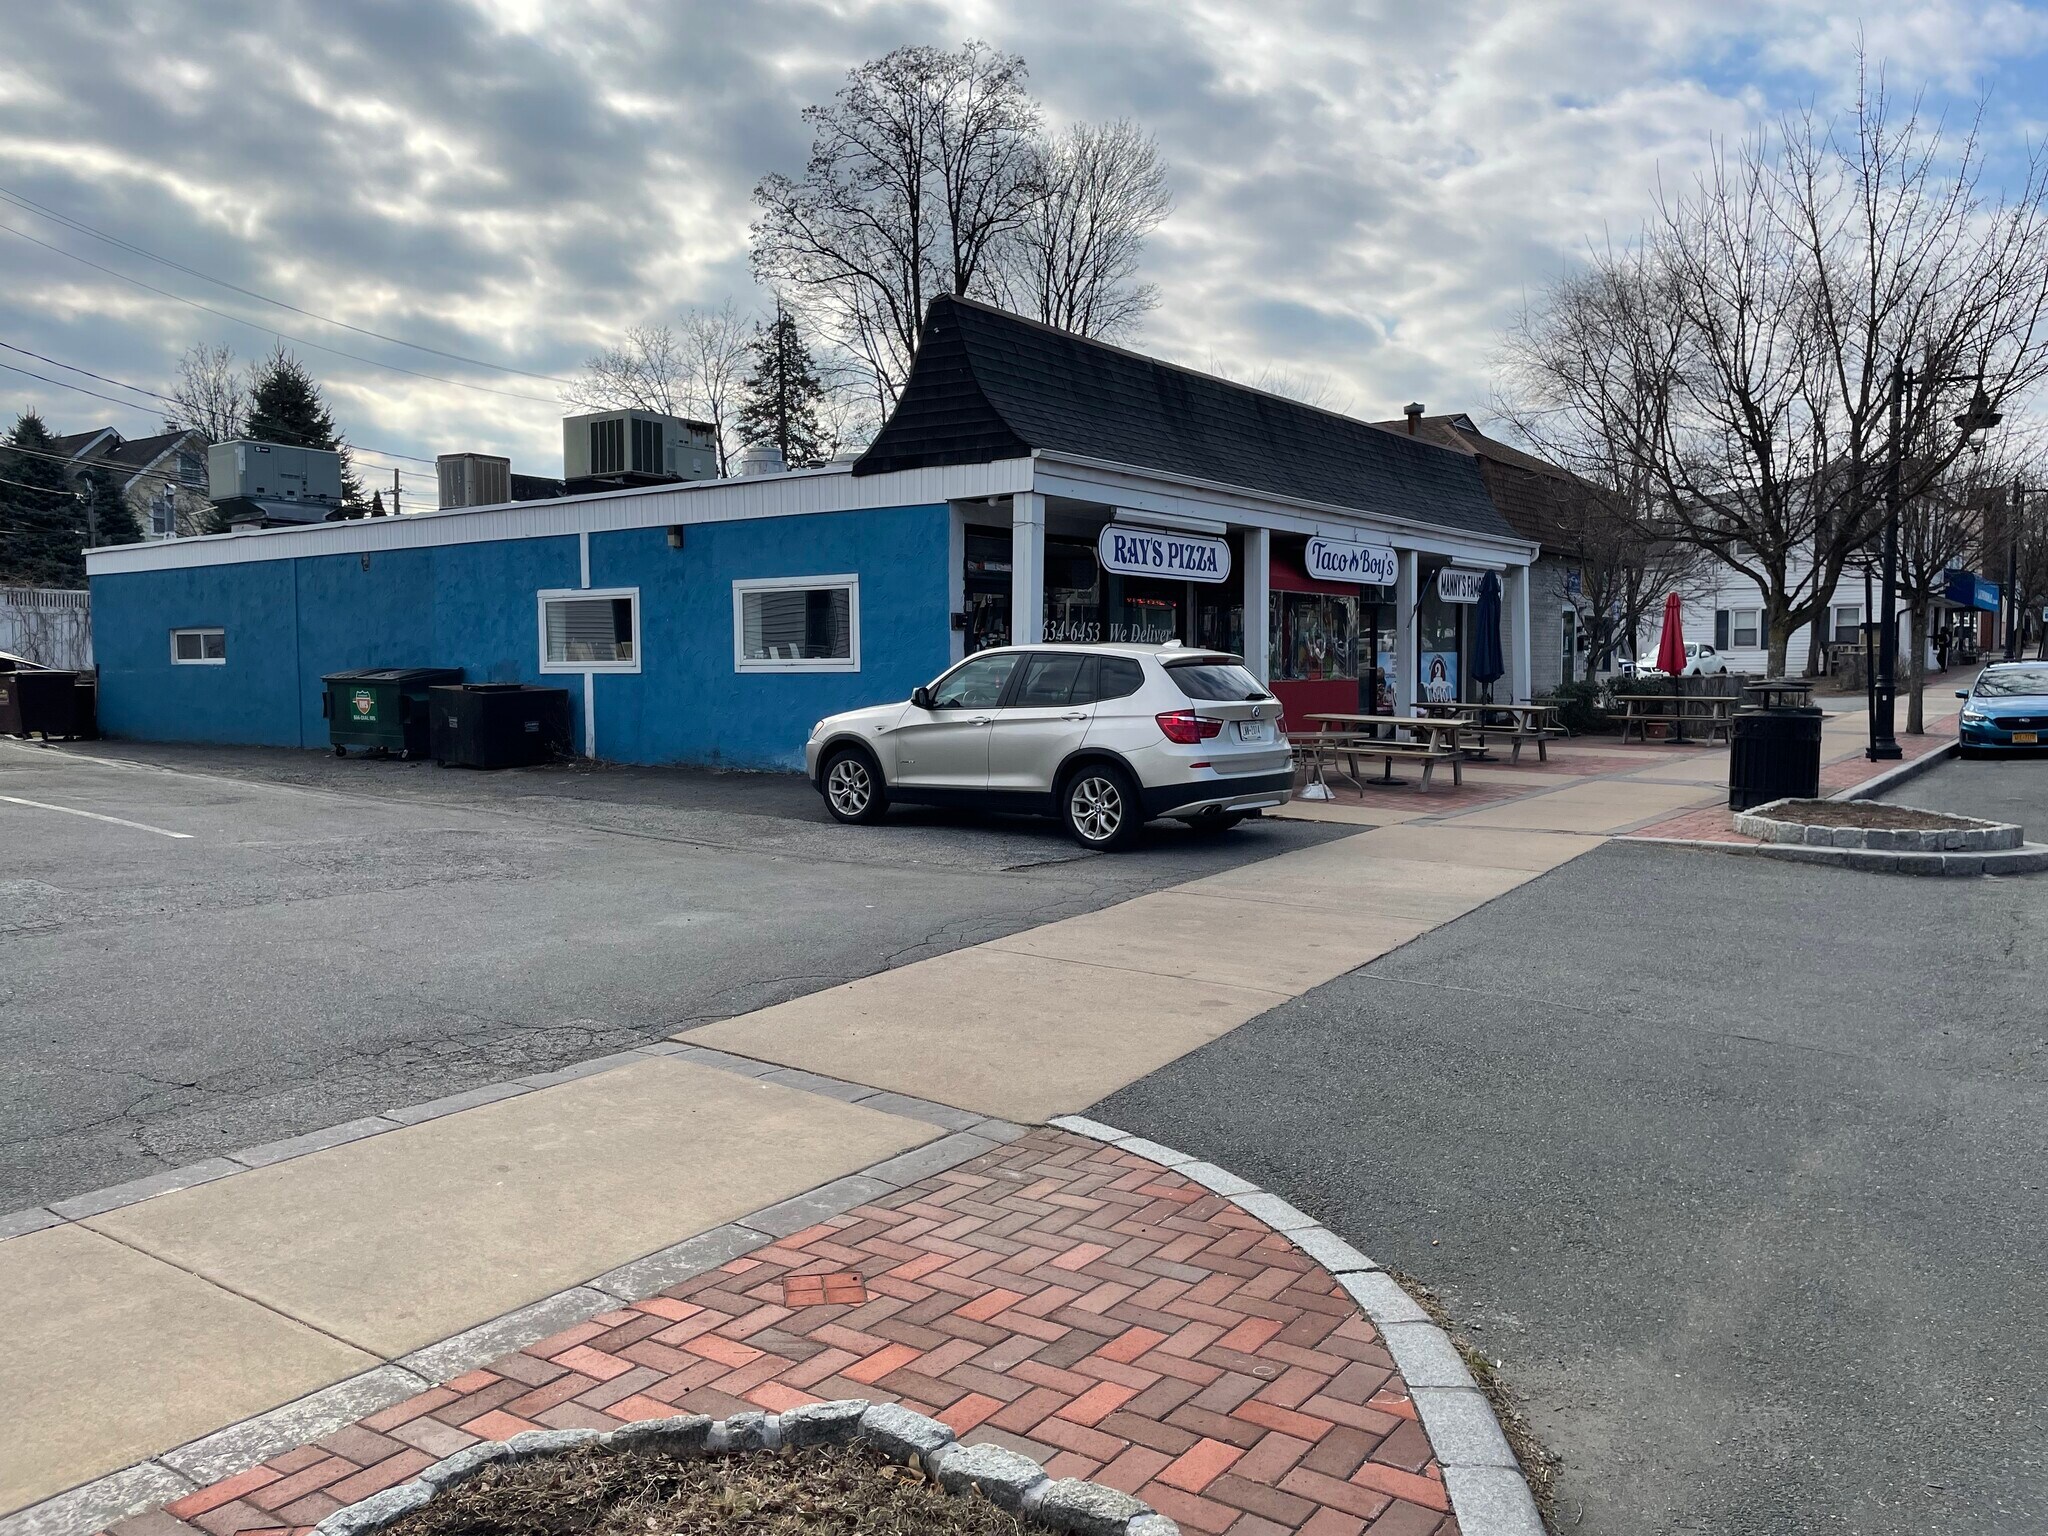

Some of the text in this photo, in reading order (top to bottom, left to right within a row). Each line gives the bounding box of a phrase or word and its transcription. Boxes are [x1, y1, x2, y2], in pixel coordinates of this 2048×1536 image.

[1113, 535, 1218, 573] RAY'S PIZZA
[1312, 542, 1394, 582] Taco Boy's
[1441, 572, 1467, 597] MANNY'S
[1109, 623, 1128, 642] We
